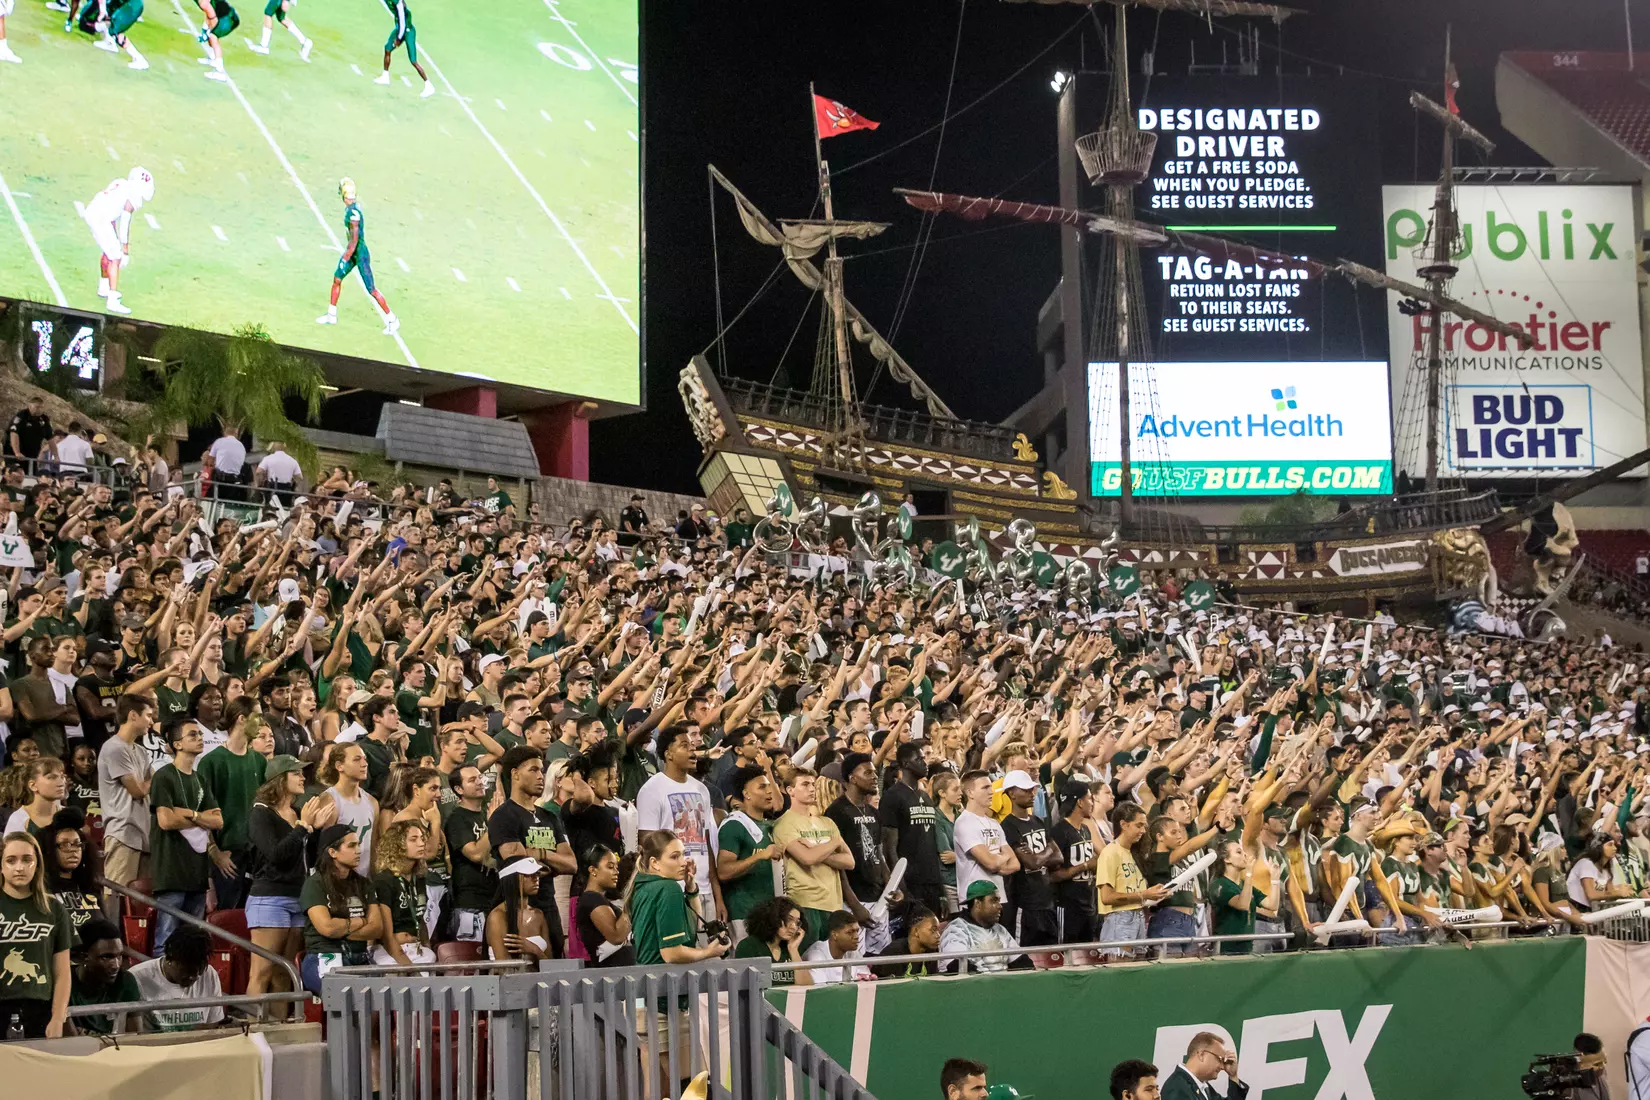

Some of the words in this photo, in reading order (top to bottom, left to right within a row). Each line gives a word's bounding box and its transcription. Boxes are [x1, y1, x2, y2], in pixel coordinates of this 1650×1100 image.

[1553, 54, 1580, 67] 344
[1138, 108, 1321, 131] DESIGNATED
[1176, 135, 1286, 158] DRIVER
[1164, 160, 1194, 174] GET
[1197, 160, 1209, 174] A
[1212, 160, 1251, 174] FREE
[1255, 160, 1299, 174] SODA
[1153, 177, 1202, 192] WHEN
[1205, 177, 1240, 192] YOU
[1245, 177, 1311, 192] PLEDGE.
[1151, 195, 1180, 209] SEE
[1184, 195, 1235, 209] GUEST
[1239, 195, 1314, 209] SERVICES
[1386, 208, 1617, 261] Publix
[1170, 283, 1225, 297] RETURN
[1228, 283, 1261, 297] LOST
[1265, 283, 1301, 297] FANS
[1179, 300, 1198, 315] TO
[1201, 300, 1242, 315] THEIR
[1246, 300, 1292, 315] SEATS.
[1163, 318, 1189, 332] SEE
[1192, 318, 1236, 332] GUEST
[1239, 318, 1311, 332] SERVICES.
[1412, 309, 1611, 352] Frontier
[31, 320, 99, 379] 14
[1415, 356, 1603, 371] CMMUNICATIONS
[1473, 395, 1564, 425] BUD
[1456, 428, 1583, 459] LIGHT
